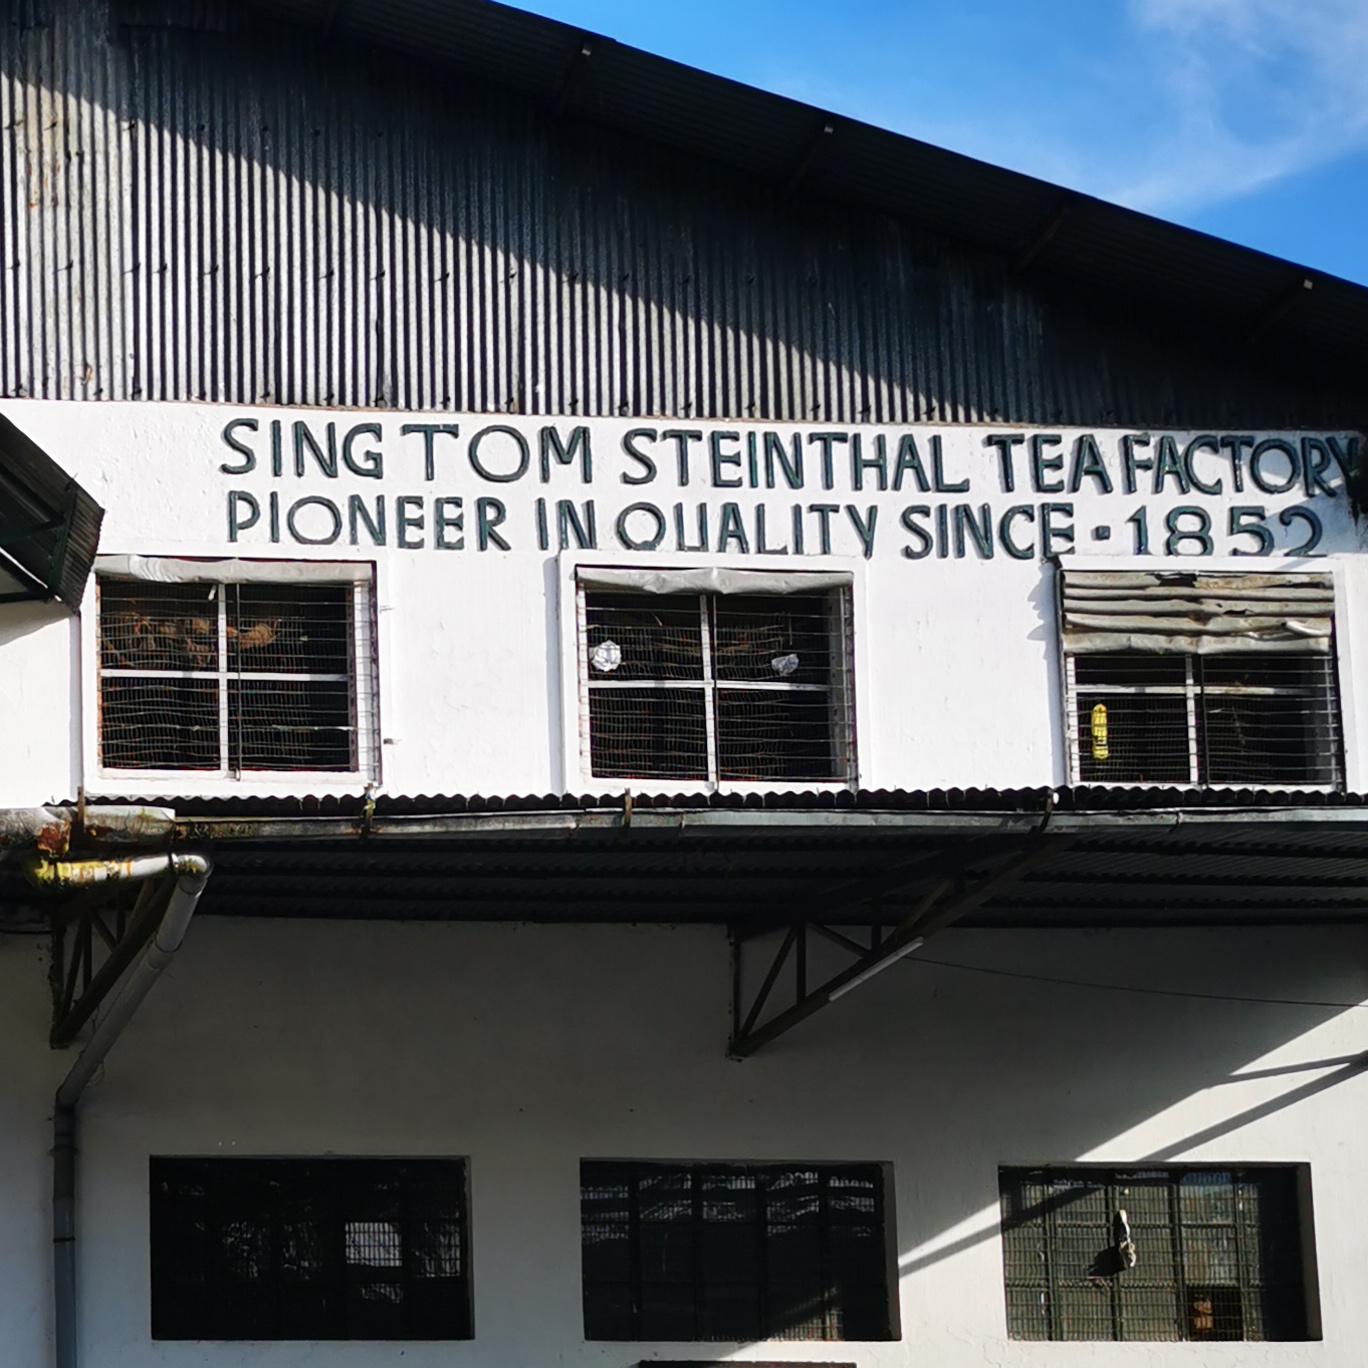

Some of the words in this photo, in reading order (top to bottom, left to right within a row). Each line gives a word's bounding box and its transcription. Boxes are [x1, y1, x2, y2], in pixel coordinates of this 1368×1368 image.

[619, 427, 970, 493] STEINTHAL
[227, 490, 512, 551] PIONEER
[535, 497, 598, 551] IN
[616, 500, 878, 559] QUALITY
